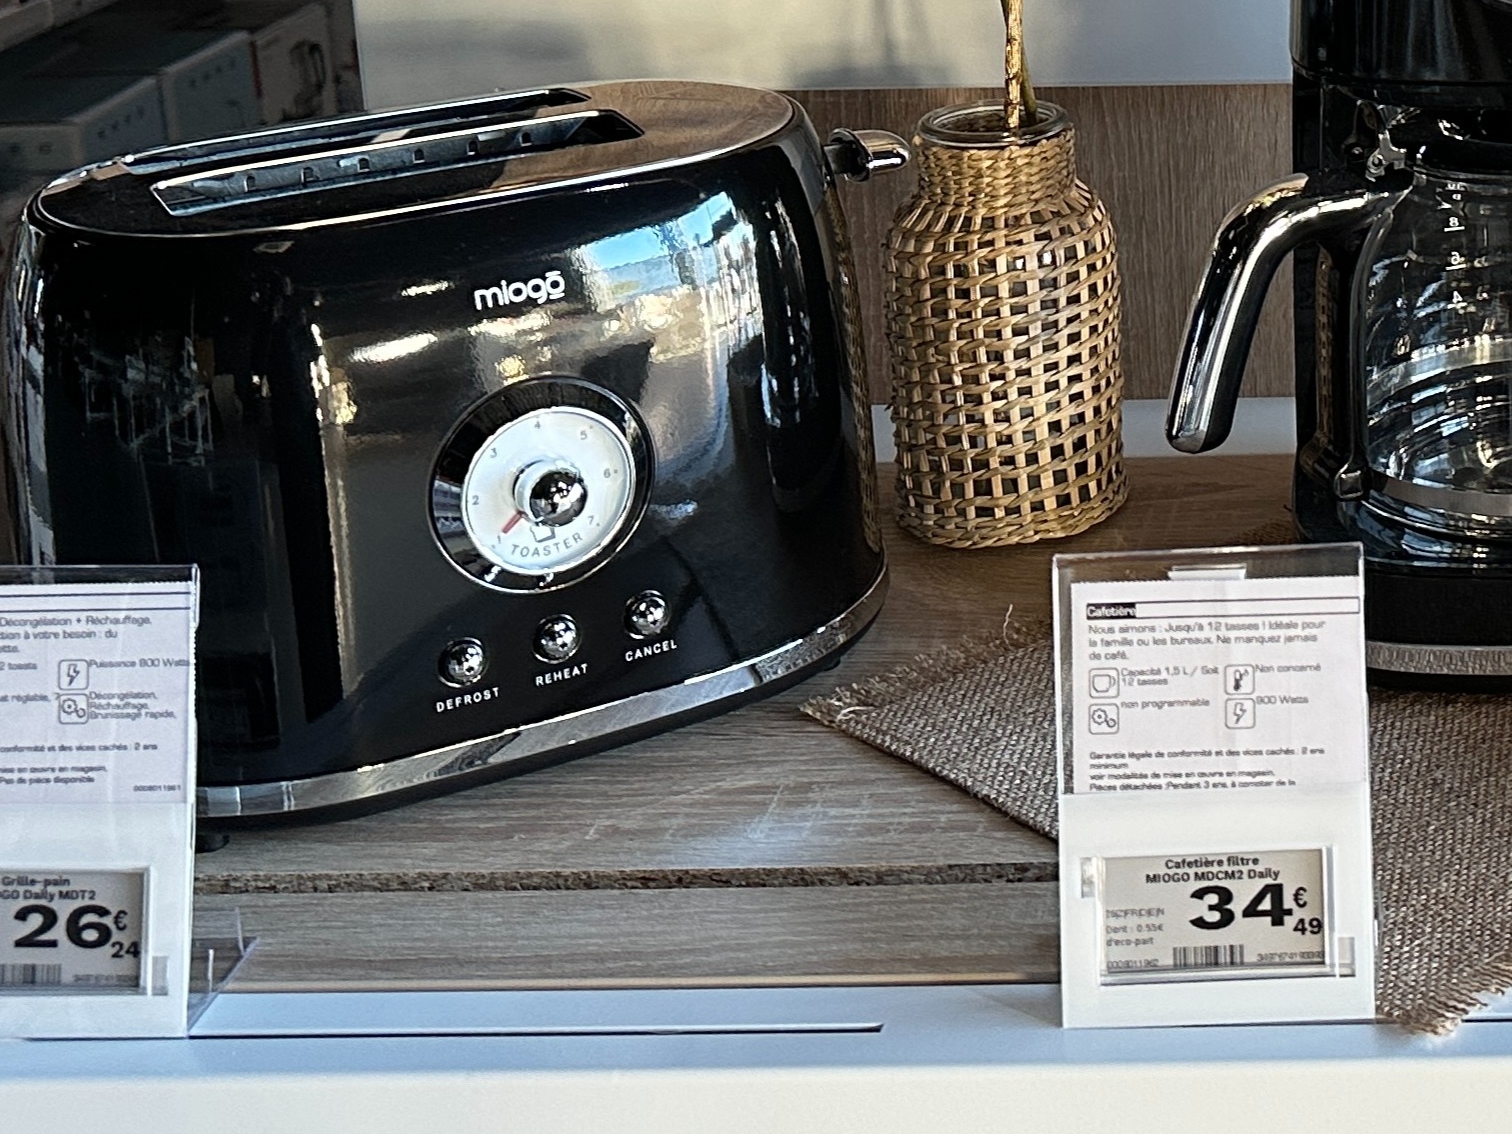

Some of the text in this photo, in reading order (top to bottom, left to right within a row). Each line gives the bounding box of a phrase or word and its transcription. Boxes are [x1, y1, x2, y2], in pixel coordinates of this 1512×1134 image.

[534, 420, 541, 430] 4
[580, 430, 588, 440] 5
[490, 447, 498, 458] 3
[603, 468, 611, 479] 6
[472, 494, 480, 506] 2
[588, 515, 595, 525] 7
[511, 531, 584, 558] TOASTER
[1088, 624, 1116, 634] Nous
[1207, 621, 1222, 631] 12
[624, 639, 678, 662] CANCEL
[534, 663, 589, 688] REHEAT
[436, 687, 500, 713] DEFROST
[1165, 855, 1260, 870] Cafetière filtre
[2, 875, 71, 889] Grille-pain
[1145, 868, 1280, 884] MIOGO MDCM2 Daily
[0, 888, 96, 903] GO Daily MDT2
[1293, 887, 1307, 908] €
[1189, 883, 1293, 930] 34
[13, 904, 140, 959] 26 € 24
[1293, 917, 1323, 936] 49
